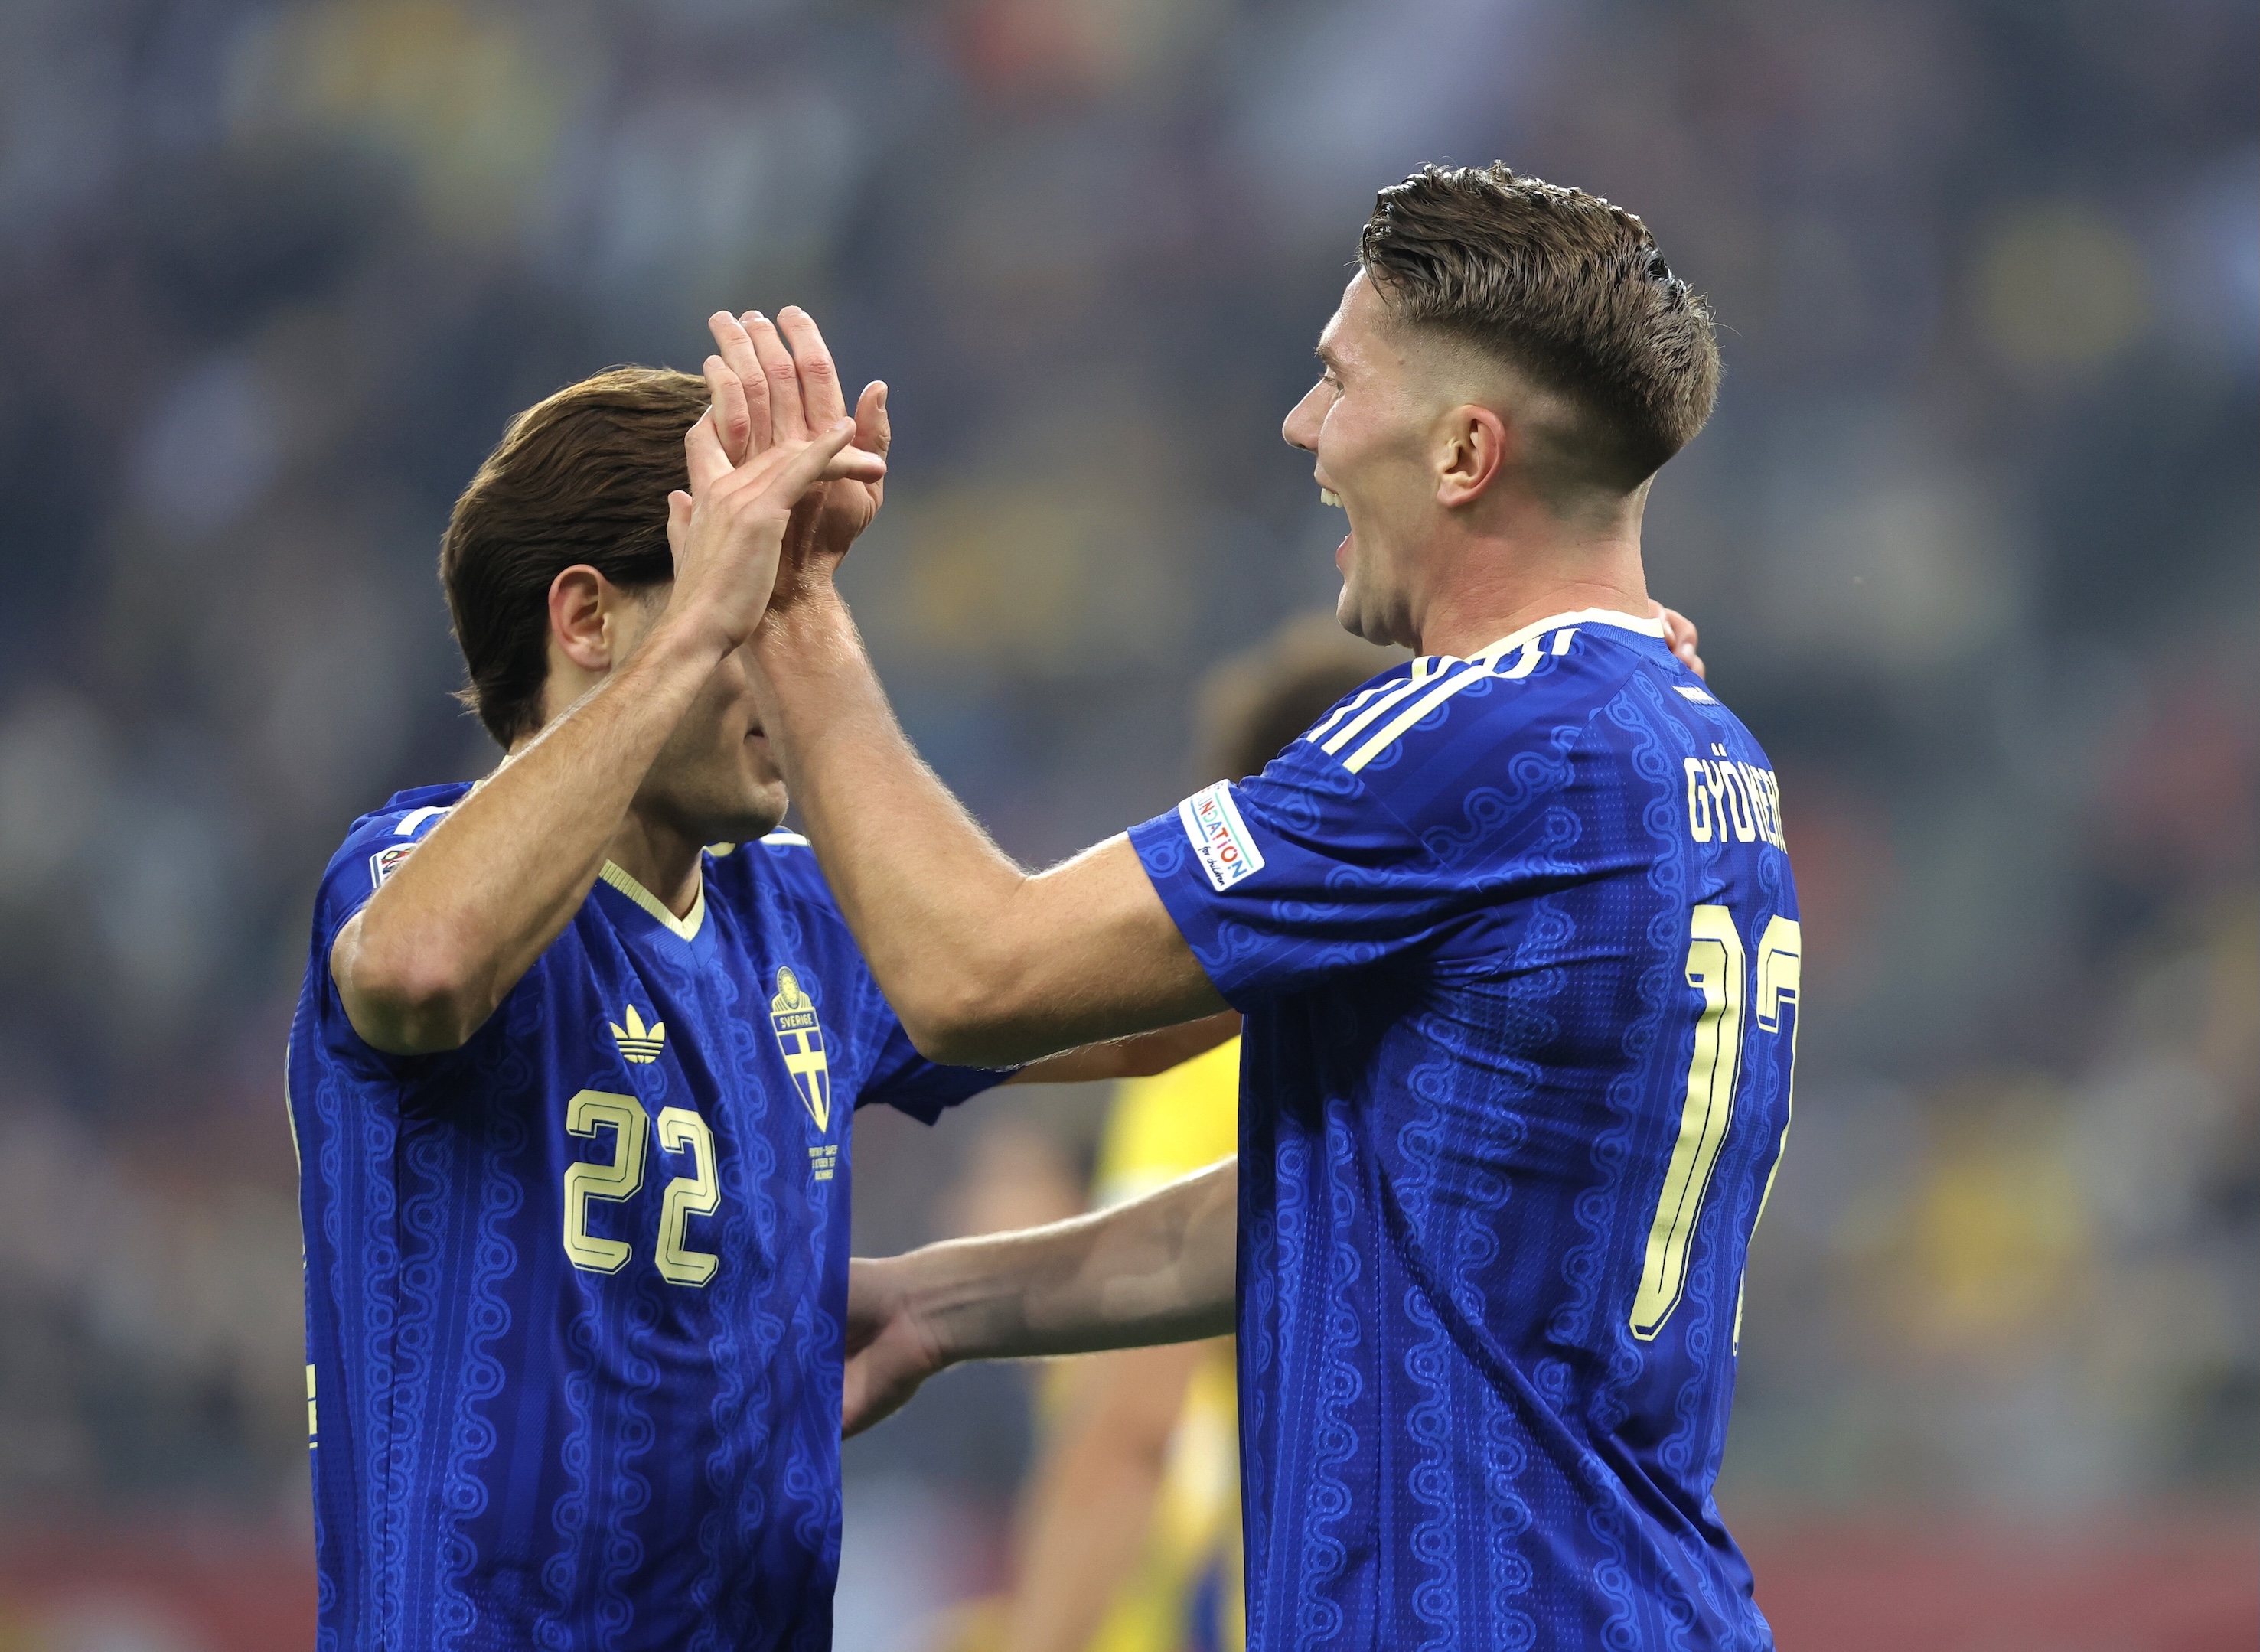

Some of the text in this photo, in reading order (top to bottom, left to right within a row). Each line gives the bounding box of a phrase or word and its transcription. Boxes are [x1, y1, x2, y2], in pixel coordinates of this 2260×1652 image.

[1198, 794, 1247, 879] NDATION
[1198, 845, 1225, 886] for children
[779, 1013, 814, 1029] SVERIGE
[563, 1088, 722, 1288] 22
